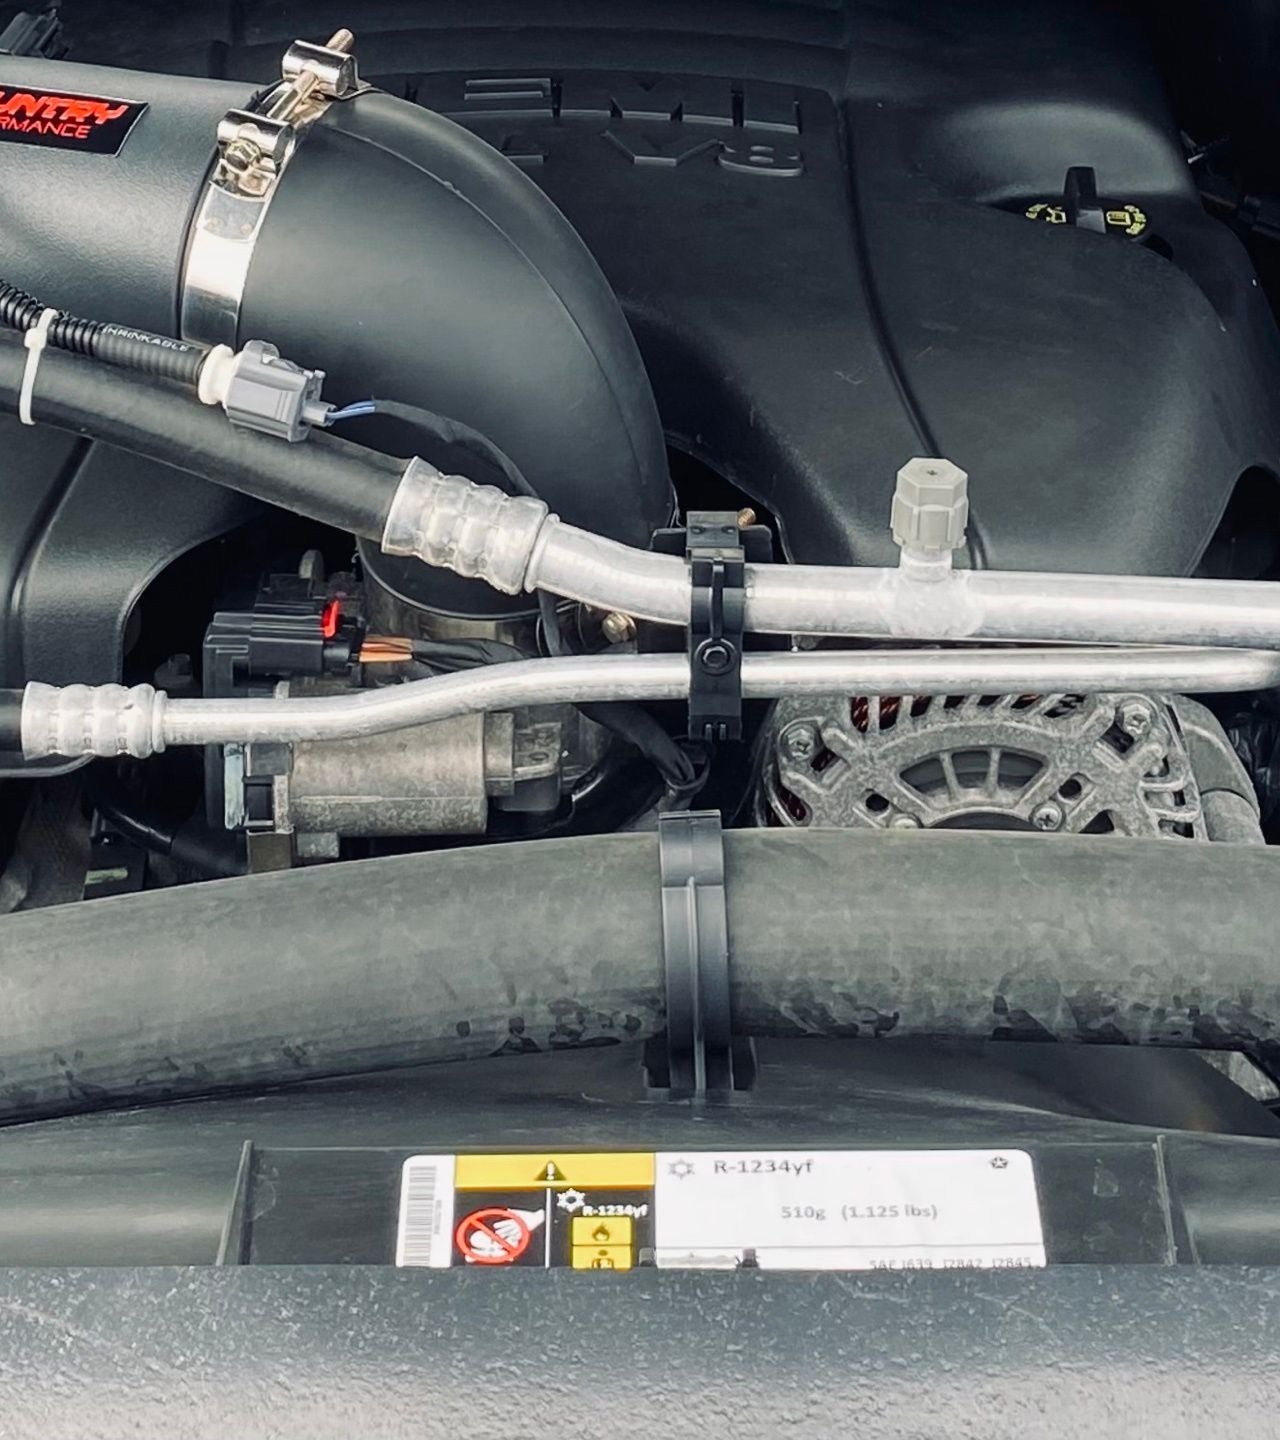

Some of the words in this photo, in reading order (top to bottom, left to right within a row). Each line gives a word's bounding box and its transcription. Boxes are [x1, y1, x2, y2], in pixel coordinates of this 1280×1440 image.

[713, 1159, 814, 1176] R-1234yf
[581, 1203, 649, 1220] R-1234yf
[781, 1205, 827, 1221] 510g
[841, 1204, 900, 1221] (1.125
[904, 1203, 939, 1221] lbs)
